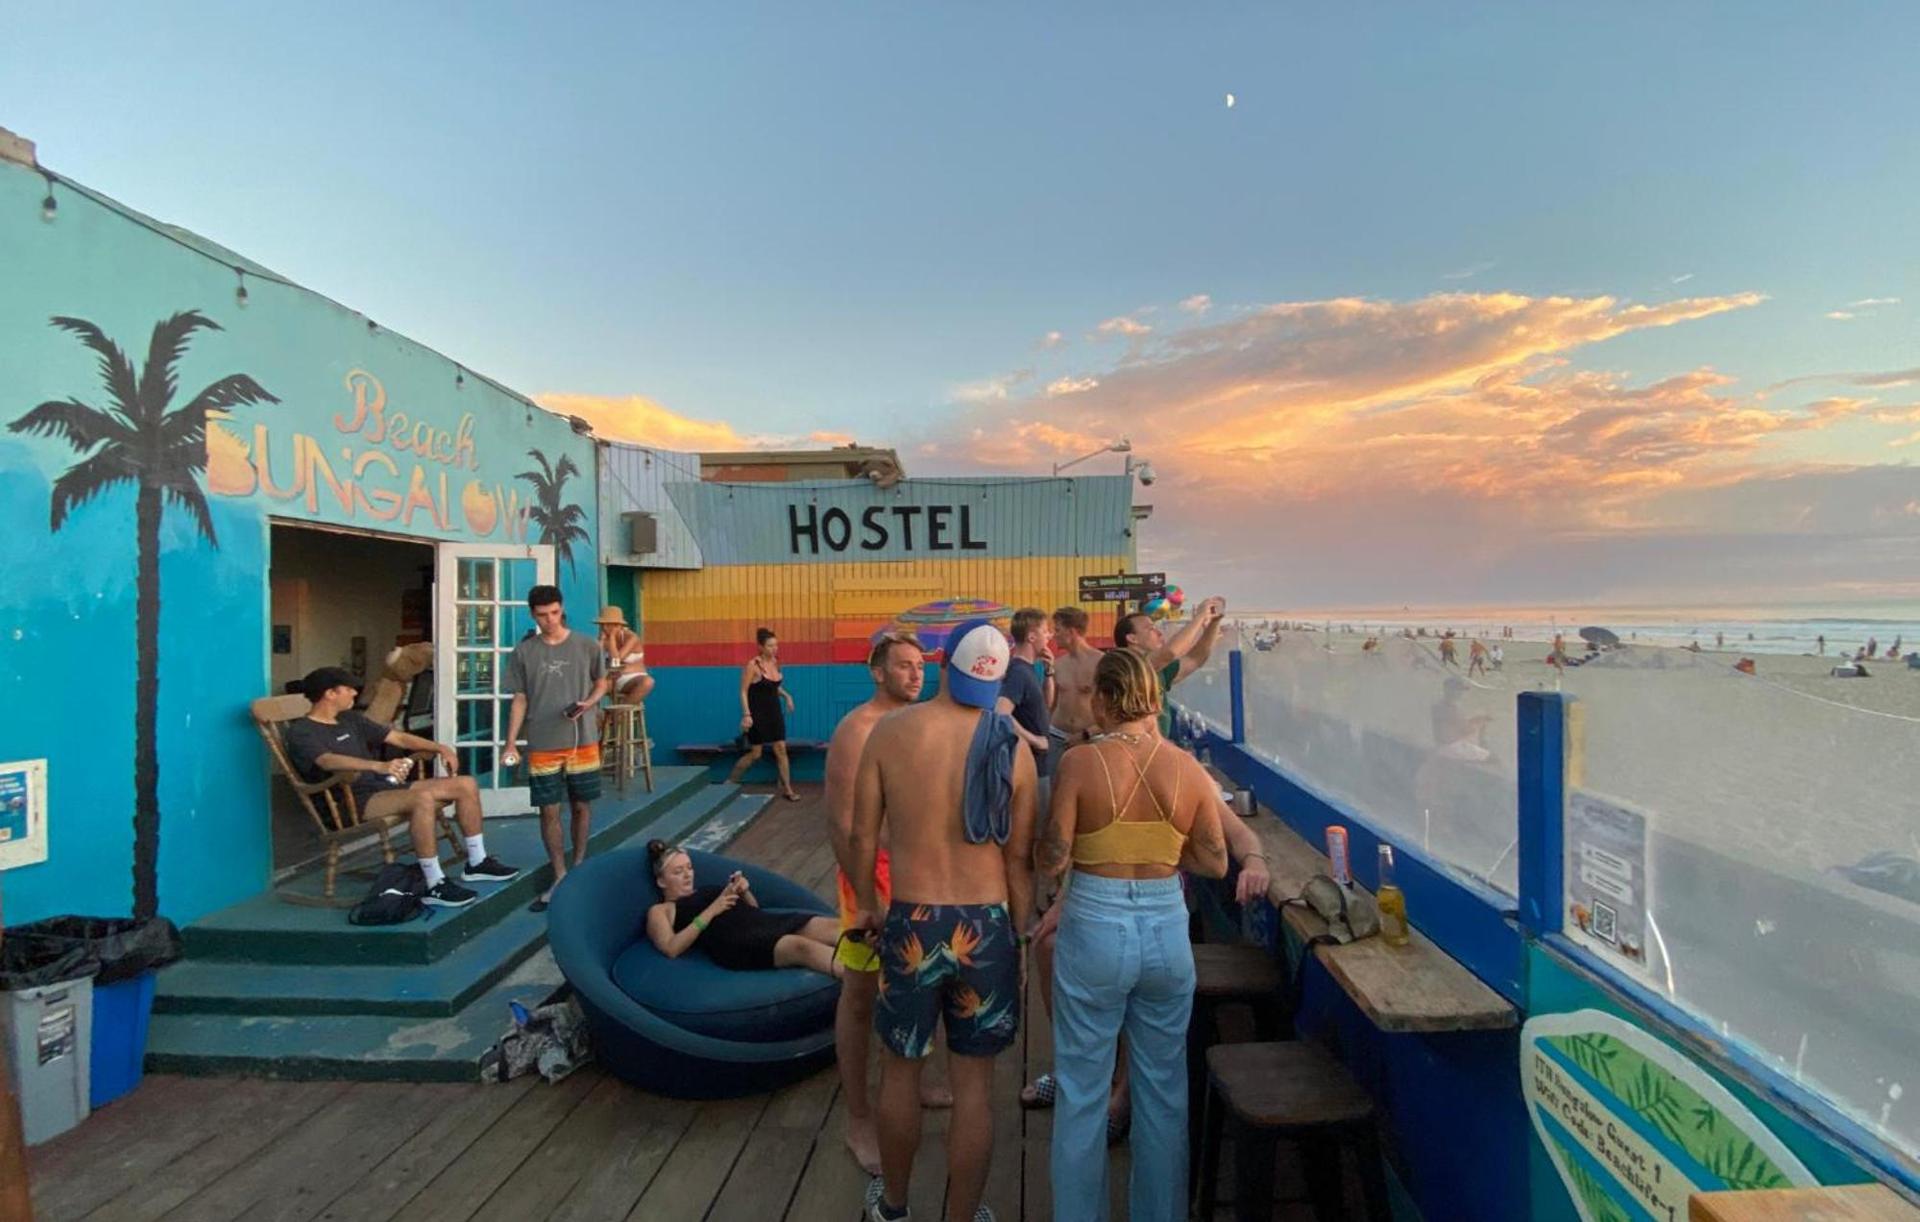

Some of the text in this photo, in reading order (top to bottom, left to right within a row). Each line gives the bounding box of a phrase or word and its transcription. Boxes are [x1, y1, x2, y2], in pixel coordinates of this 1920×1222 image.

[333, 367, 479, 472] Beach
[204, 408, 532, 546] BUNGALOW
[788, 504, 987, 554] HOSTEL
[1607, 1122, 1646, 1172] Guest
